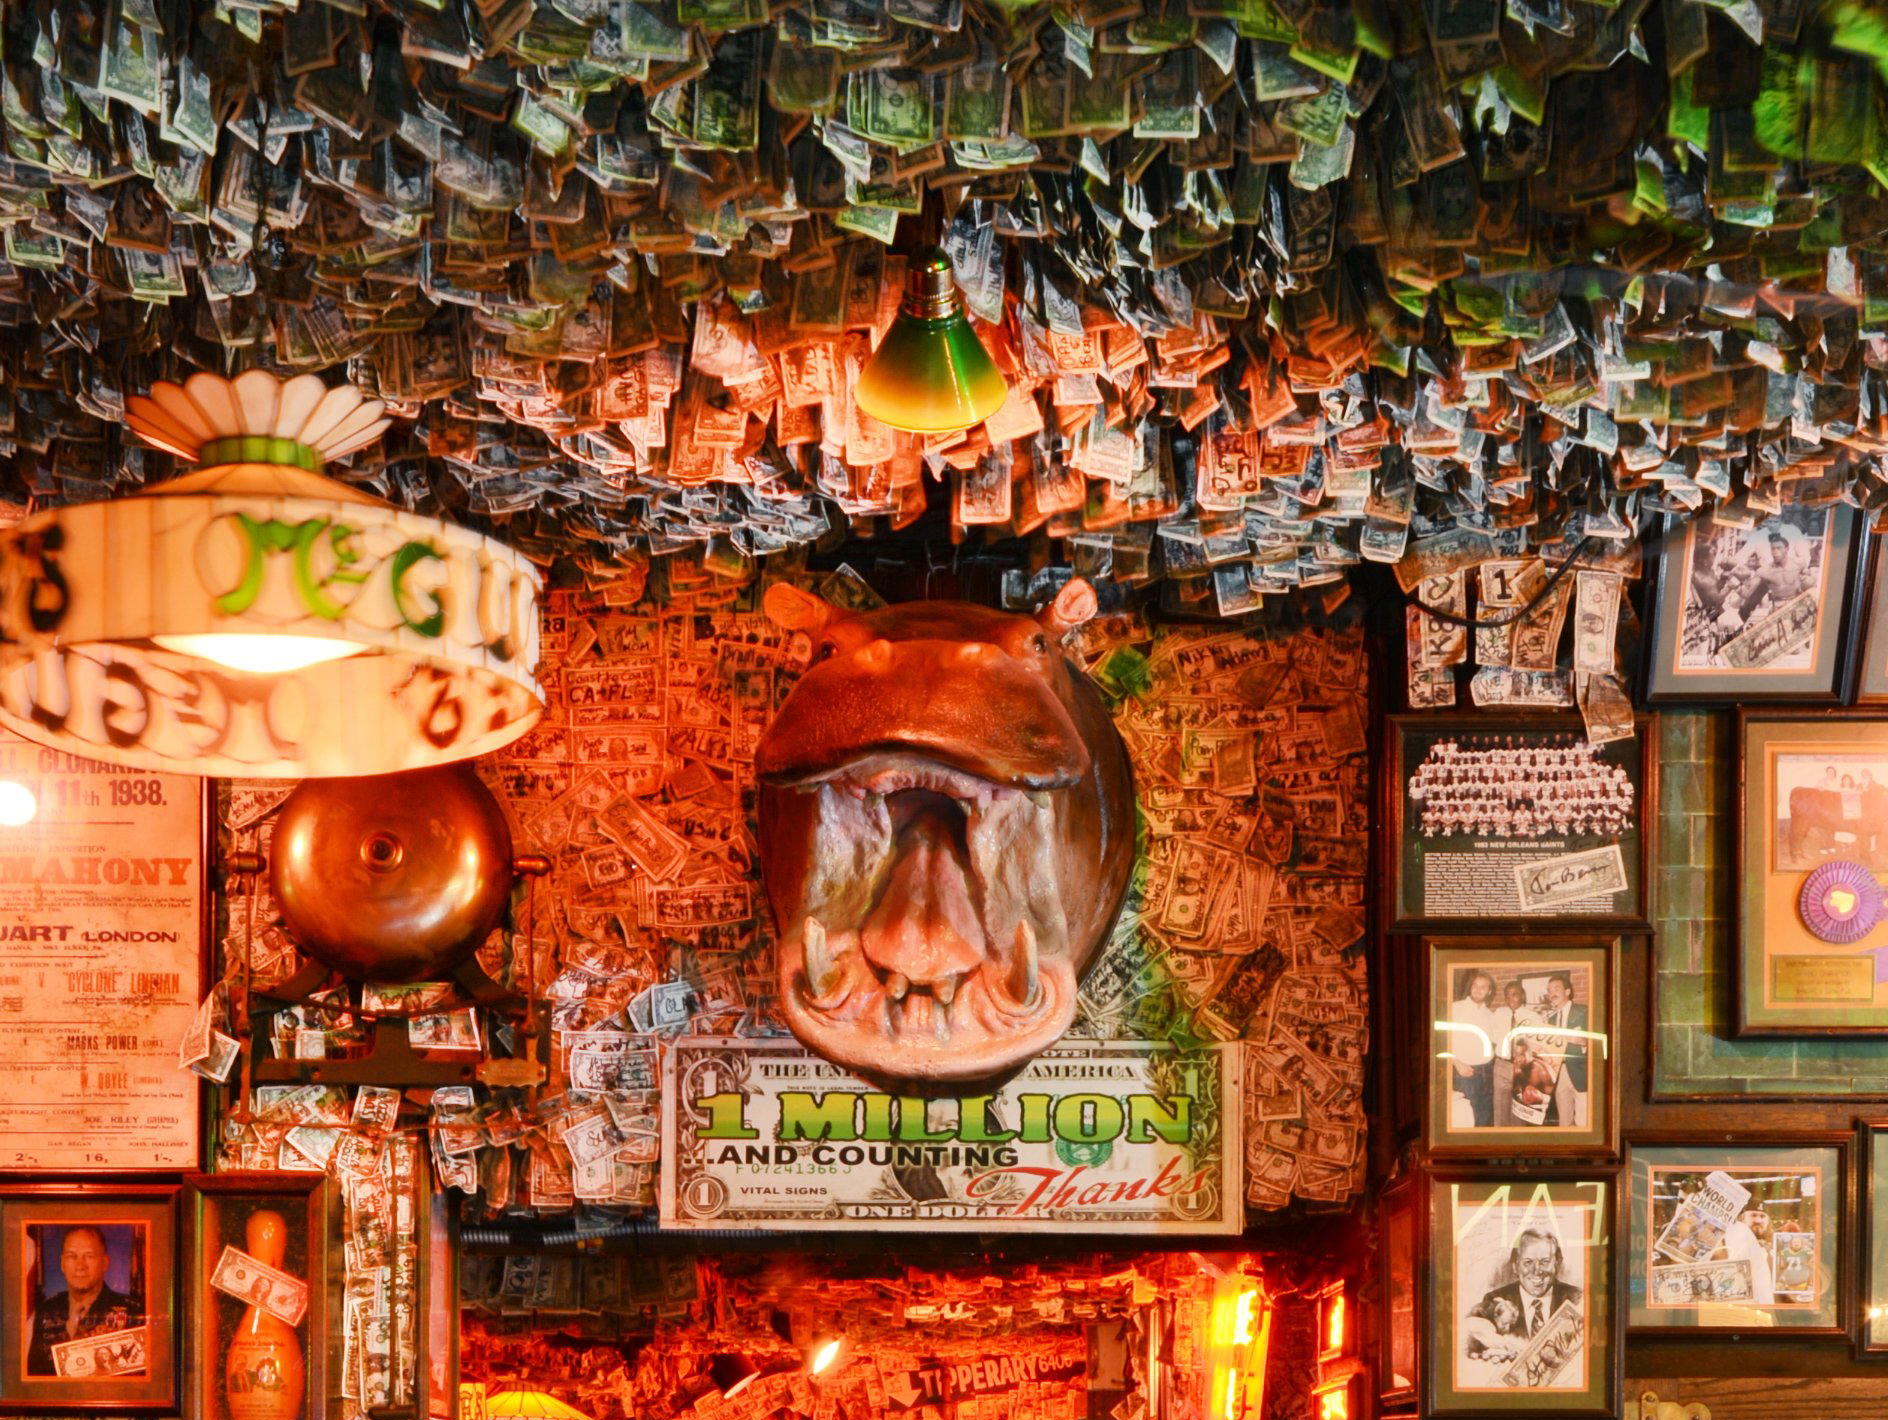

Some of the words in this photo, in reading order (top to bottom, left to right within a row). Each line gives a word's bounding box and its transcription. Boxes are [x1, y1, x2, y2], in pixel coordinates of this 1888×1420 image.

[109, 779, 167, 806] 1938.
[81, 930, 181, 943] (LONDON)
[106, 1035, 138, 1050] POWER
[759, 1063, 809, 1079] THE
[1026, 1064, 1136, 1078] AMERICA
[693, 1091, 760, 1140] 1
[776, 1090, 1195, 1144] MILLION
[811, 1145, 1019, 1167] COUNTING
[740, 1186, 781, 1195] VITAL
[785, 1186, 828, 1195] SIGNS
[965, 1154, 1216, 1216] Thanks
[1703, 1186, 1735, 1212] WORLD
[845, 1204, 914, 1218] ONE
[919, 1204, 1053, 1219] DOLLR
